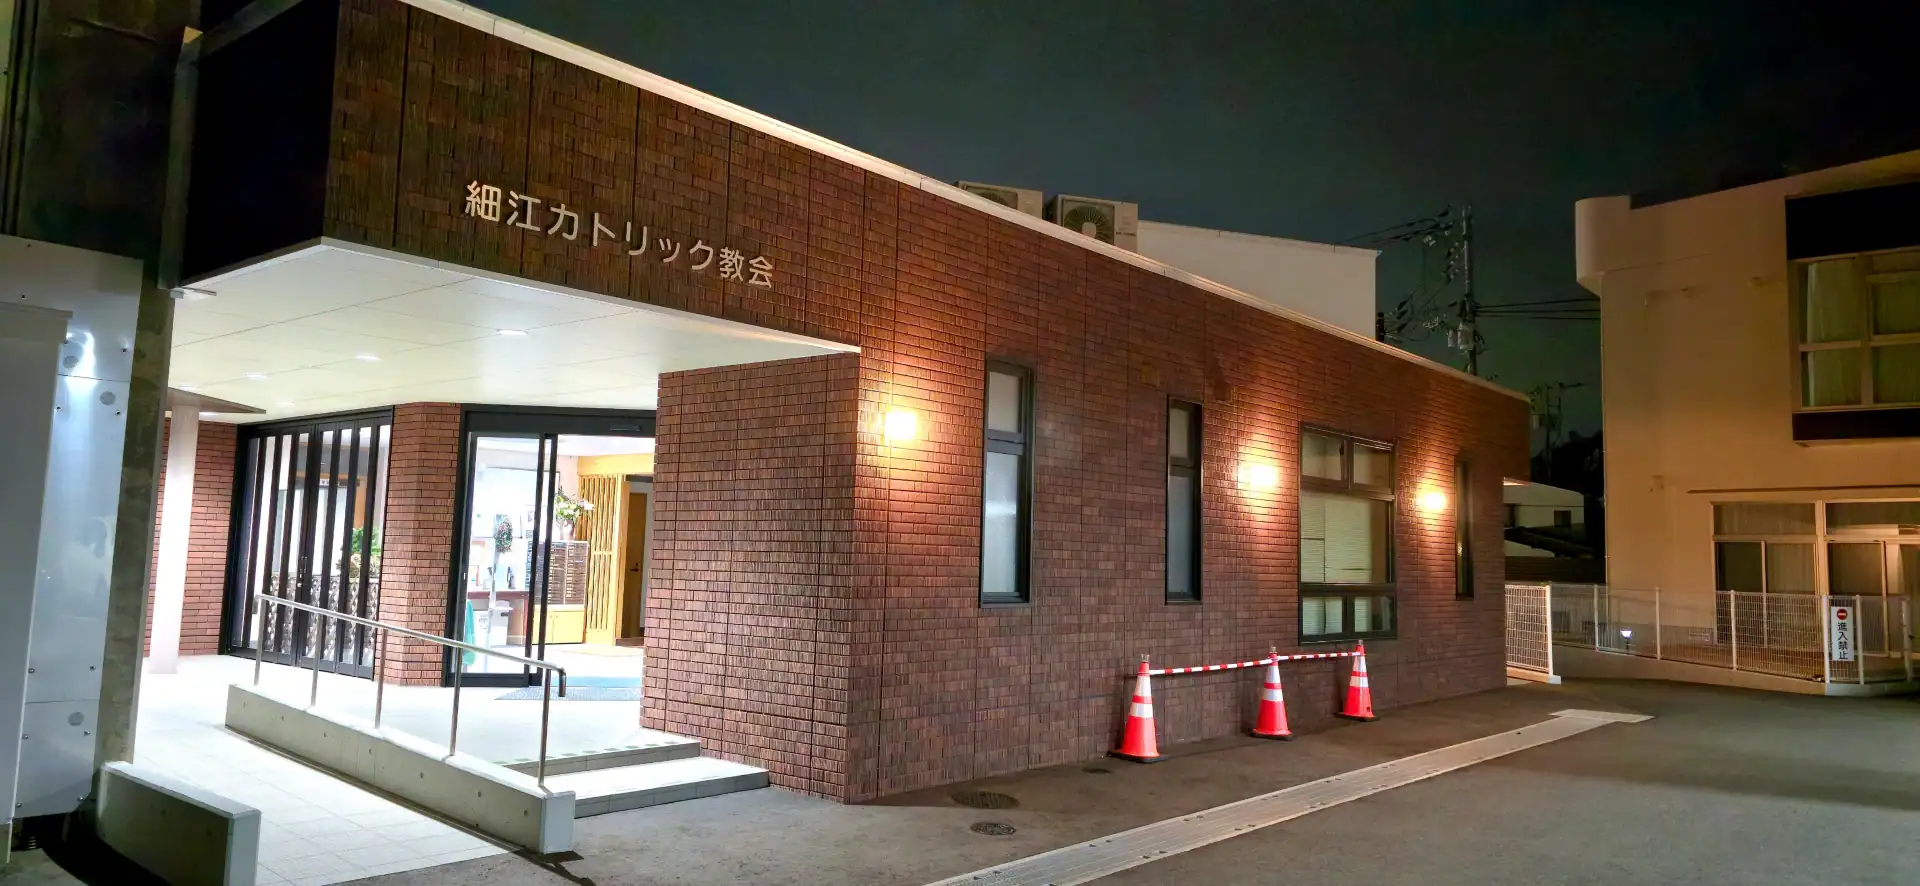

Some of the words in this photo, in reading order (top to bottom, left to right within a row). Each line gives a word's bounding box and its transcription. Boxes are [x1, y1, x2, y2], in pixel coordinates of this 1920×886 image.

[465, 180, 773, 288] 細江カトリック教会
[1837, 622, 1848, 660] 進入禁止
